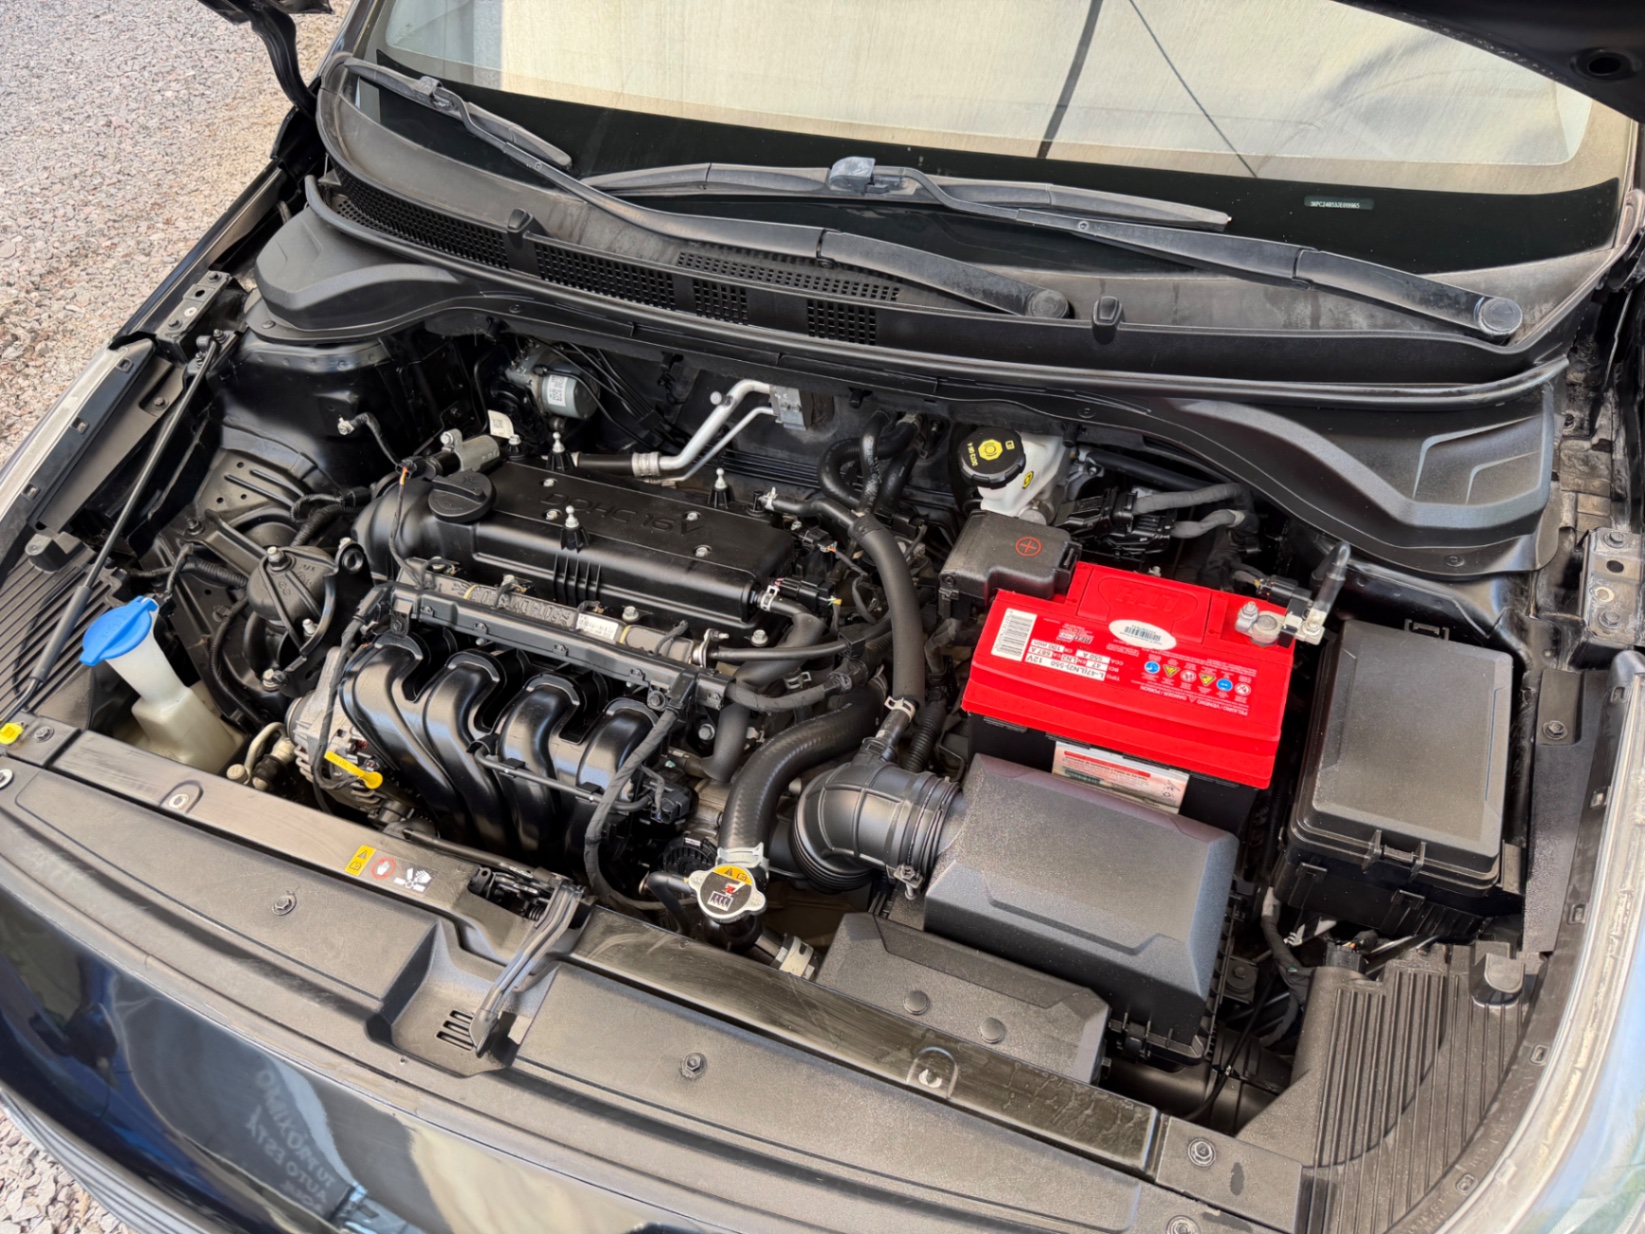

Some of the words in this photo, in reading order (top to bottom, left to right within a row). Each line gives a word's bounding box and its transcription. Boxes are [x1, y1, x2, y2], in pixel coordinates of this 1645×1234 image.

[540, 493, 637, 523] DOHC
[641, 512, 704, 535] 16V
[1027, 655, 1043, 664] 12V
[1106, 673, 1120, 681] TIPO
